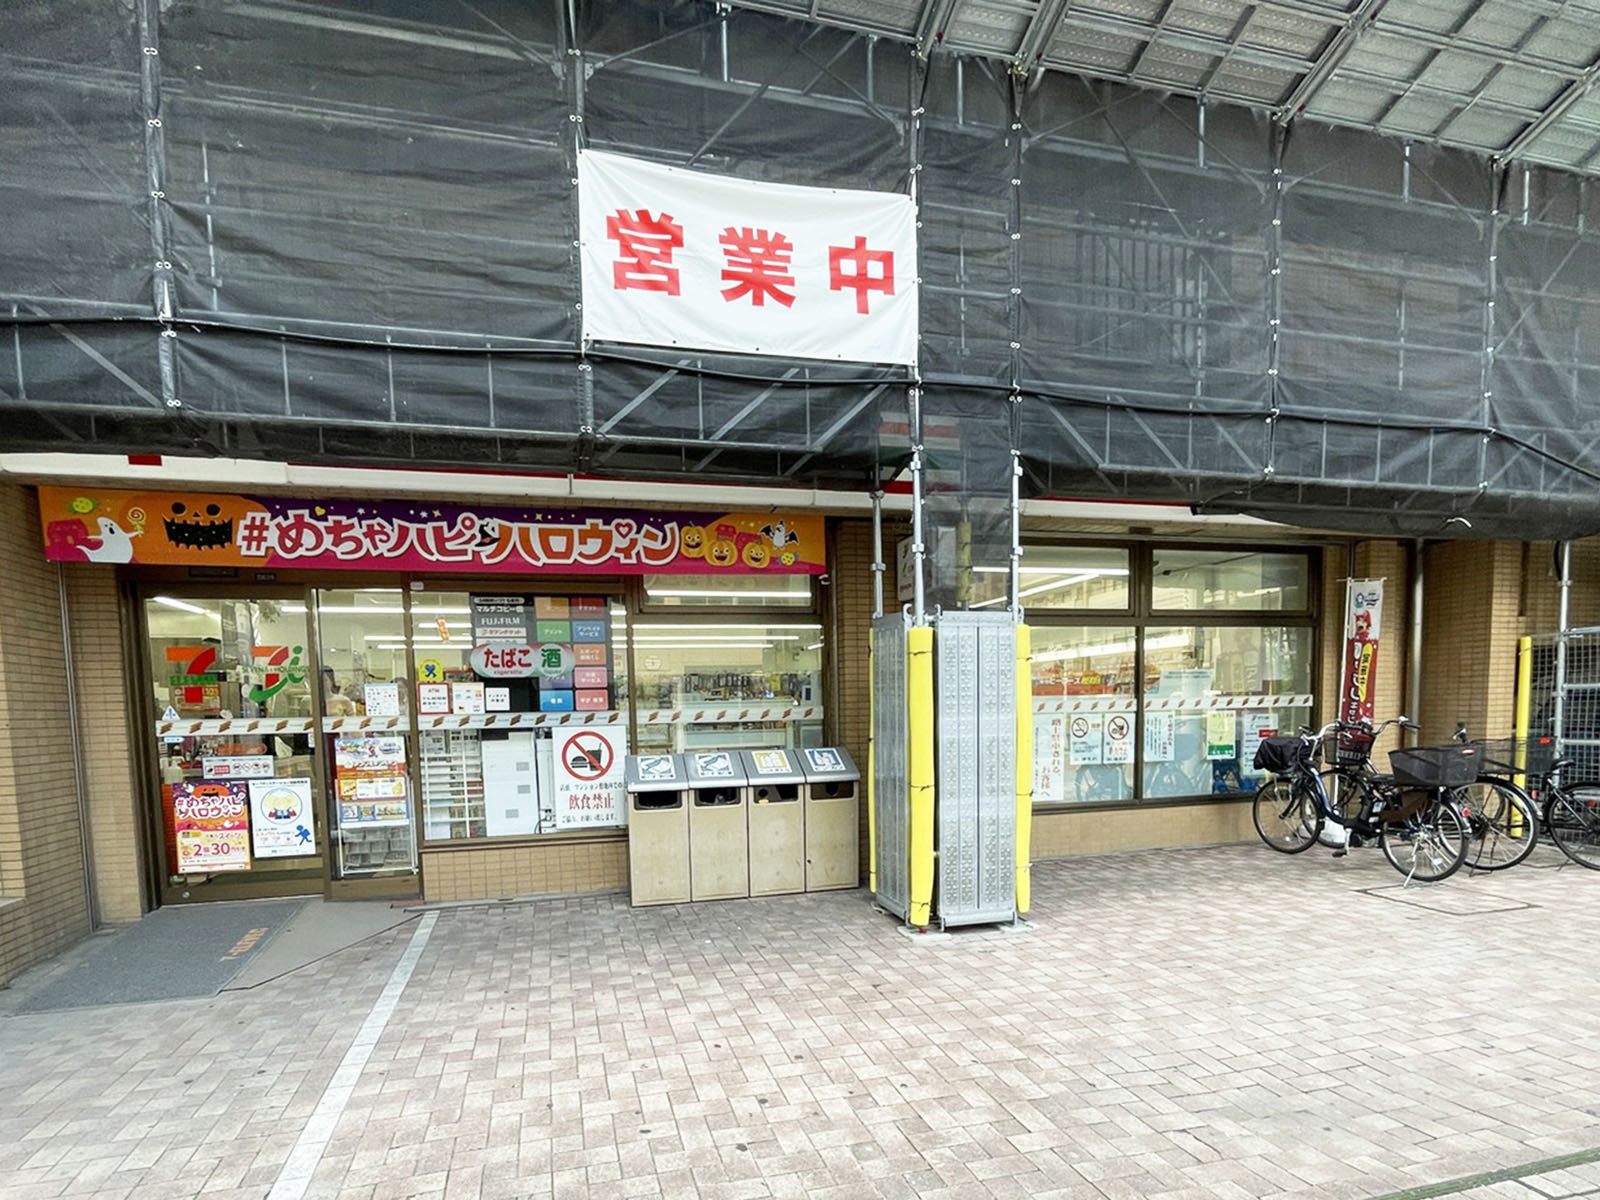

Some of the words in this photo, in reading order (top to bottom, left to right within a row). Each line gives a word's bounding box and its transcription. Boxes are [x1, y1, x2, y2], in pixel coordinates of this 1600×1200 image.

[606, 209, 895, 315] 営業中
[484, 648, 532, 669] たばこ
[541, 648, 562, 668] 酒
[569, 793, 614, 810] 飲食禁止
